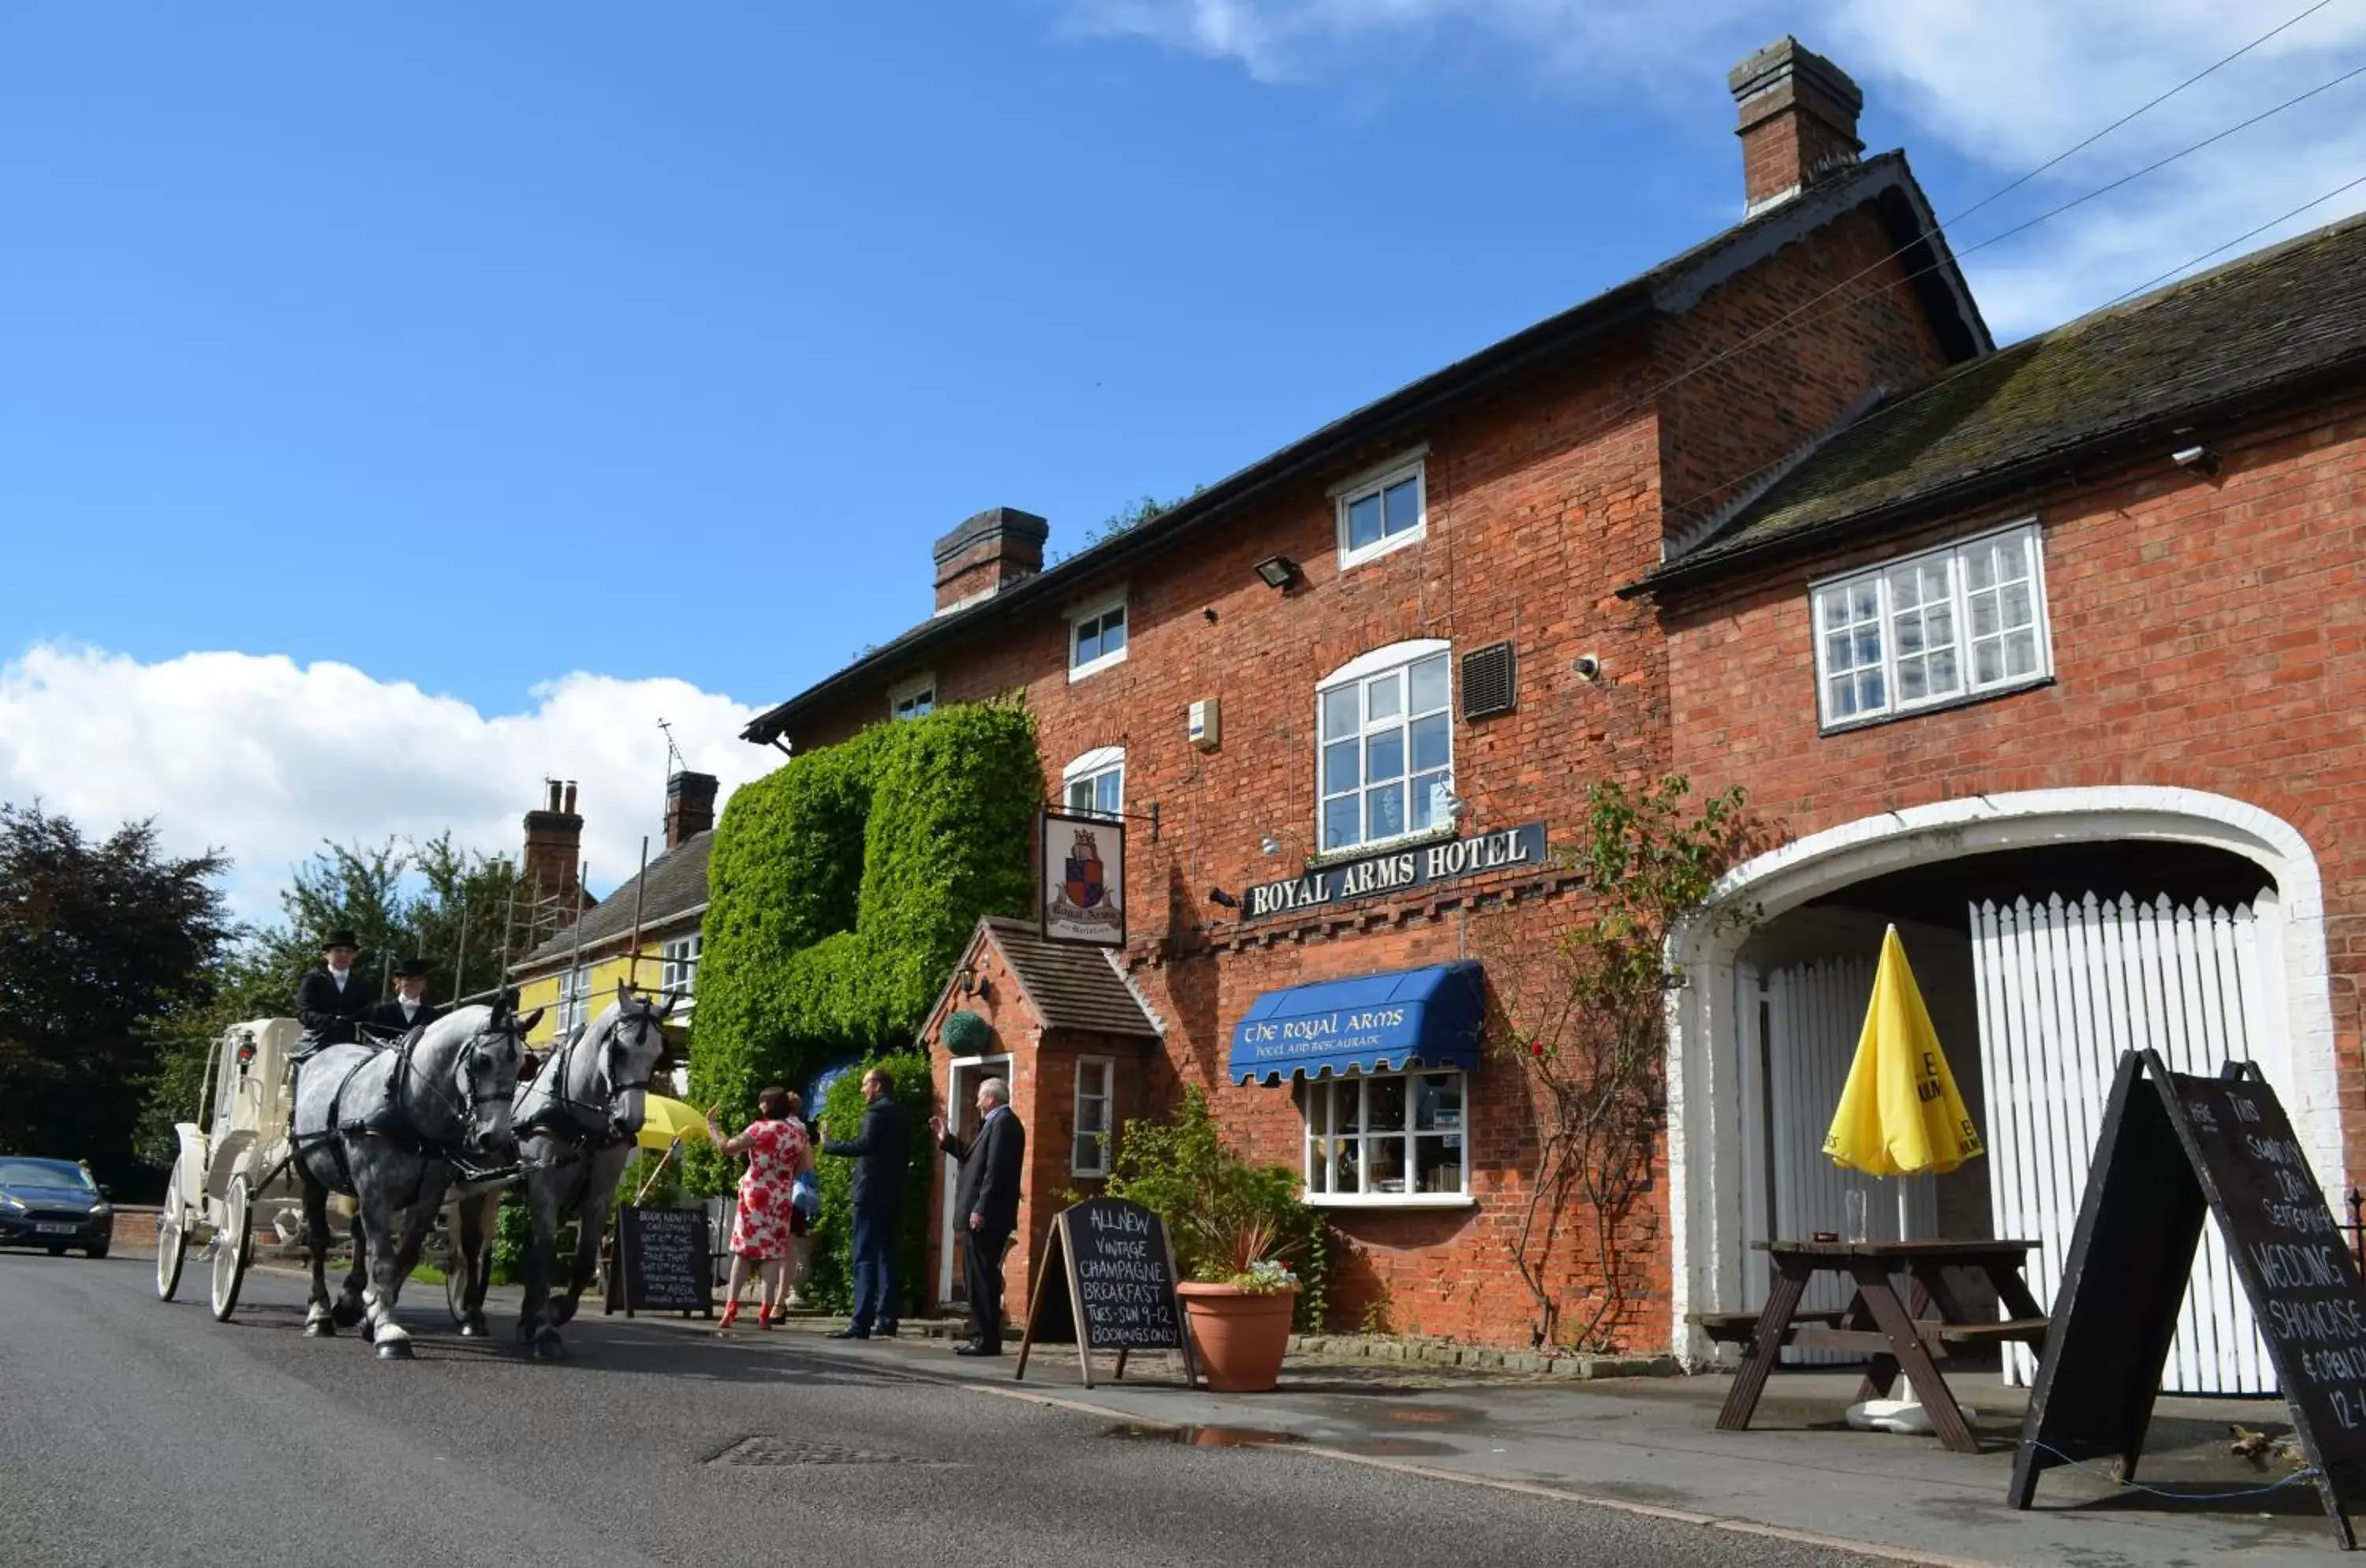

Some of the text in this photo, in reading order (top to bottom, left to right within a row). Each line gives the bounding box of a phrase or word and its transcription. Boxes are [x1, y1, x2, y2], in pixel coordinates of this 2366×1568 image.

[1252, 830, 1528, 915] ROYAL ARMS HOTEL
[1090, 1205, 1151, 1236] ALL NEW
[1095, 1237, 1148, 1260] VINTAGE
[1080, 1260, 1166, 1282] CHAMPAGNE
[2248, 1241, 2347, 1290] WEDDING
[1083, 1282, 1161, 1303] BREAKFAST
[2269, 1298, 2366, 1342] SHOWCASE
[2315, 1350, 2357, 1381] OPEN
